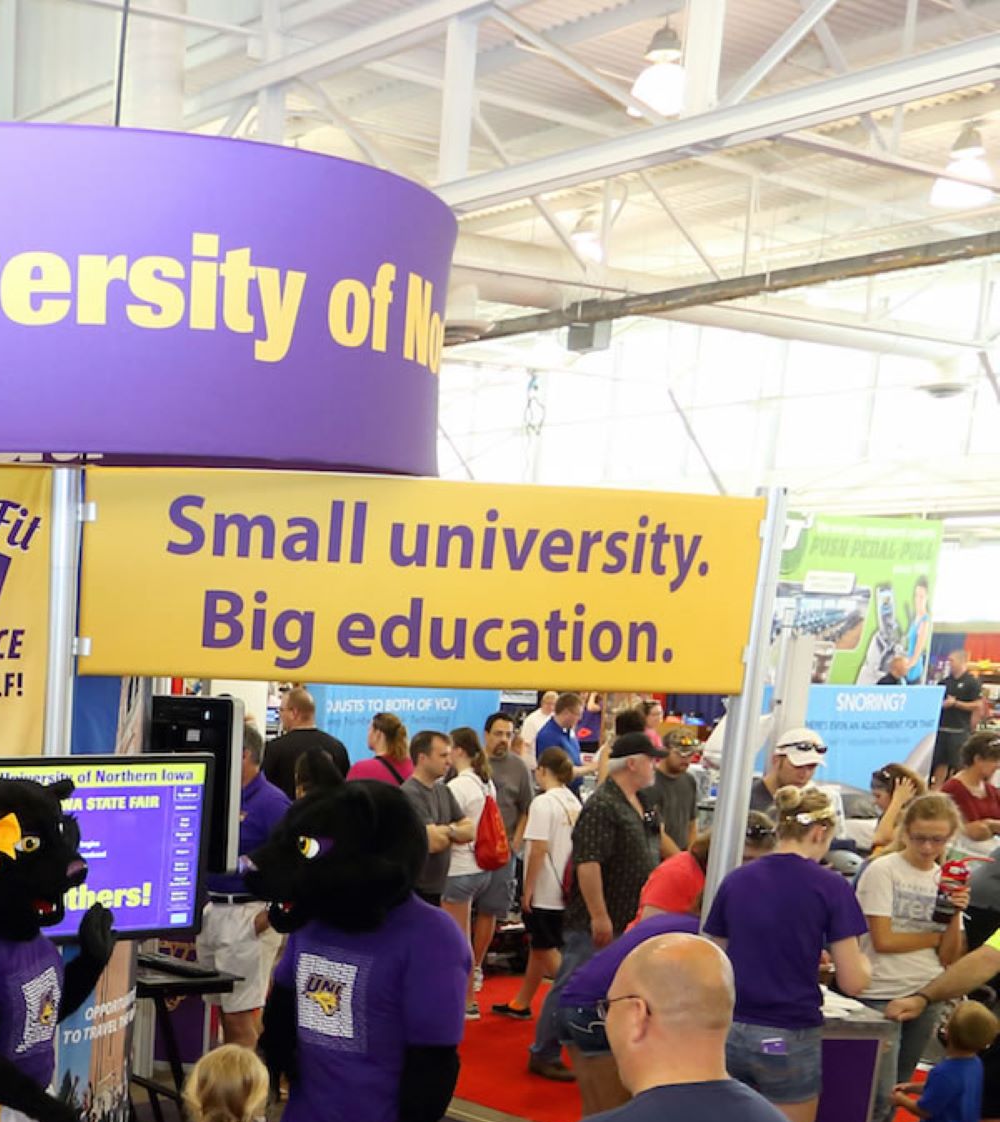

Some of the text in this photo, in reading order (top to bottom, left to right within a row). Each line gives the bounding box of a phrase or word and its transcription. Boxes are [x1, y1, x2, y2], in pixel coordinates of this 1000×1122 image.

[327, 262, 396, 353] of
[403, 271, 445, 377] No
[166, 494, 368, 565] Small
[389, 508, 711, 593] university.
[200, 588, 674, 670] Big education.
[368, 698, 384, 713] TO
[385, 697, 415, 713] BOTH
[417, 698, 433, 711] OF
[435, 697, 458, 711] YOU
[835, 691, 908, 713] SNORING?
[77, 770, 92, 783] of
[95, 768, 157, 783] Northern
[161, 767, 194, 782] Iowa
[86, 796, 127, 811] STATE
[129, 794, 161, 810] FAIR
[305, 973, 347, 995] UNI
[64, 1029, 82, 1045] TO
